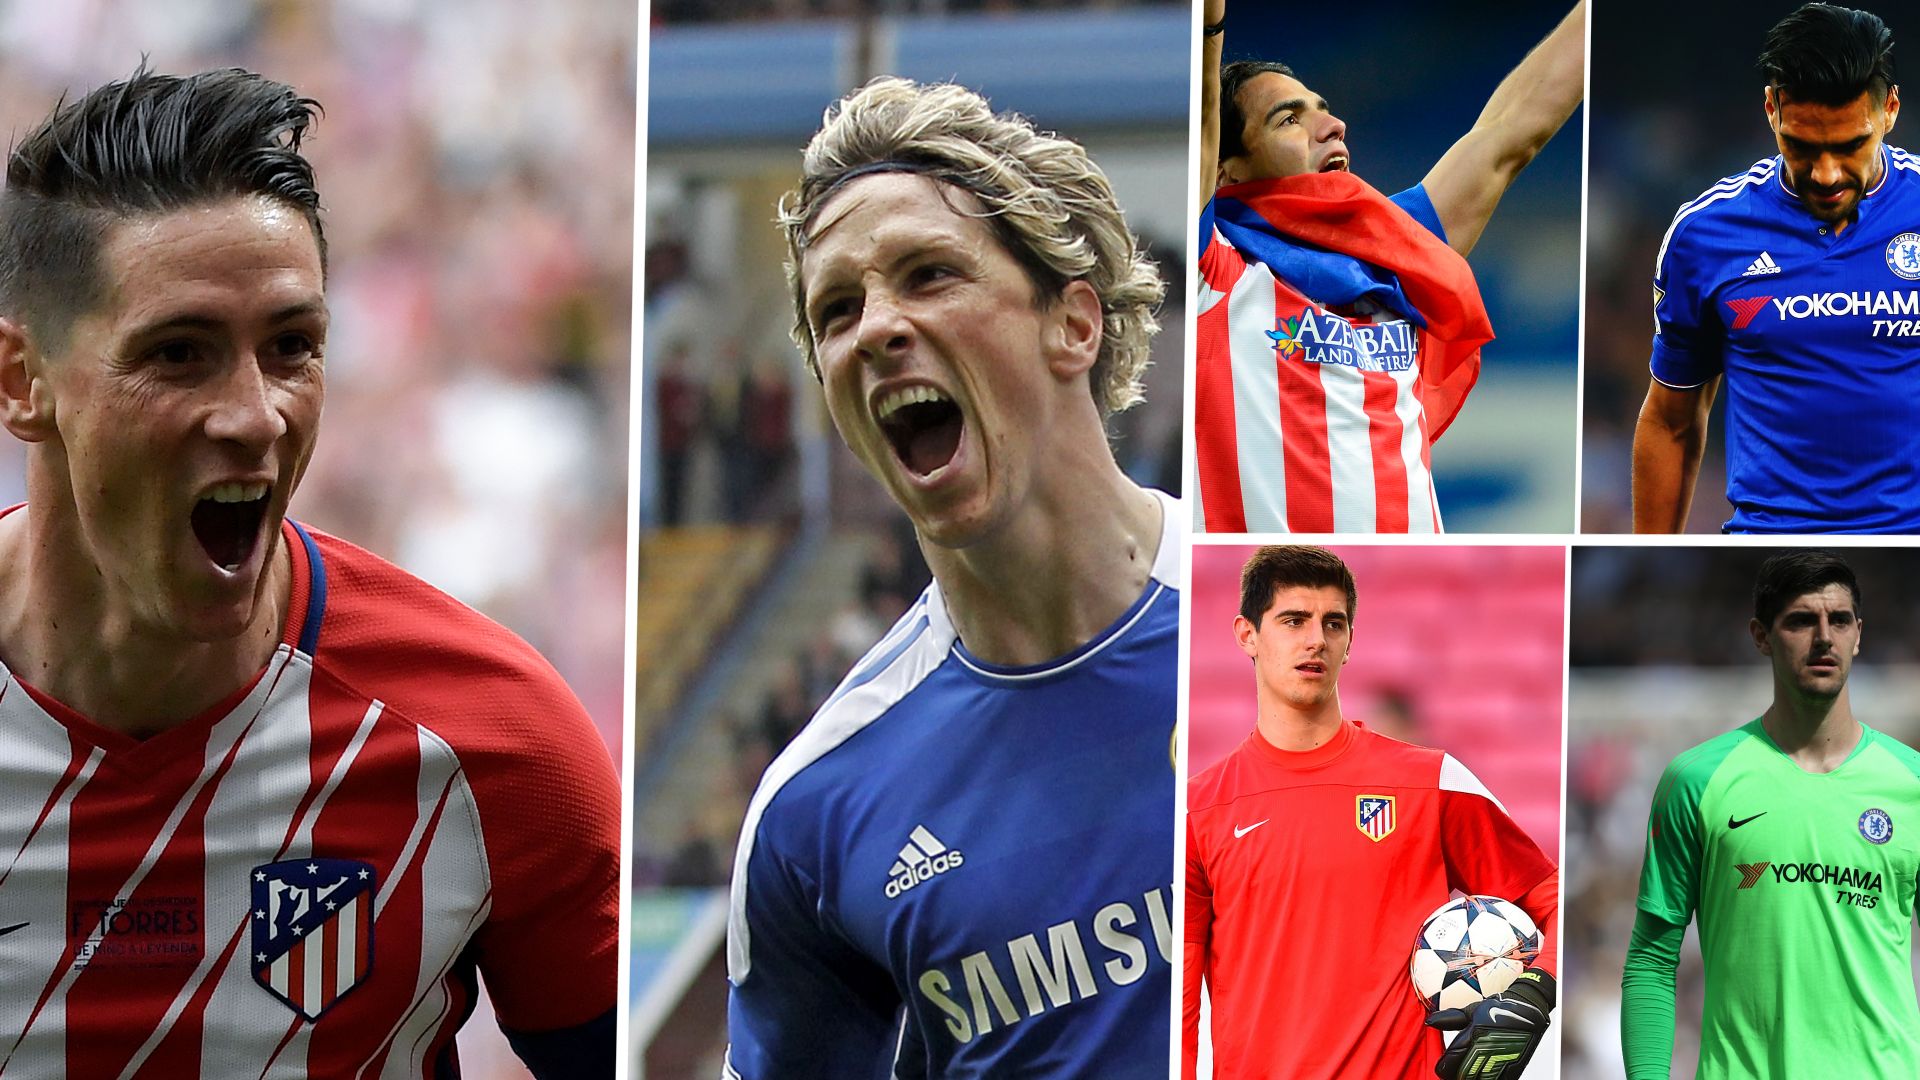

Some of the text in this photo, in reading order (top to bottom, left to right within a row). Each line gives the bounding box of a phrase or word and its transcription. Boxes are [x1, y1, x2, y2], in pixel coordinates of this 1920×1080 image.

[1772, 291, 1920, 321] YOKOHAM
[1304, 346, 1353, 365] LAND
[1376, 355, 1409, 371] FIRE
[884, 849, 965, 898] adidas
[1771, 863, 1882, 893] YOKOHAMA
[1836, 891, 1879, 909] TYRES
[98, 909, 198, 937] TORRES
